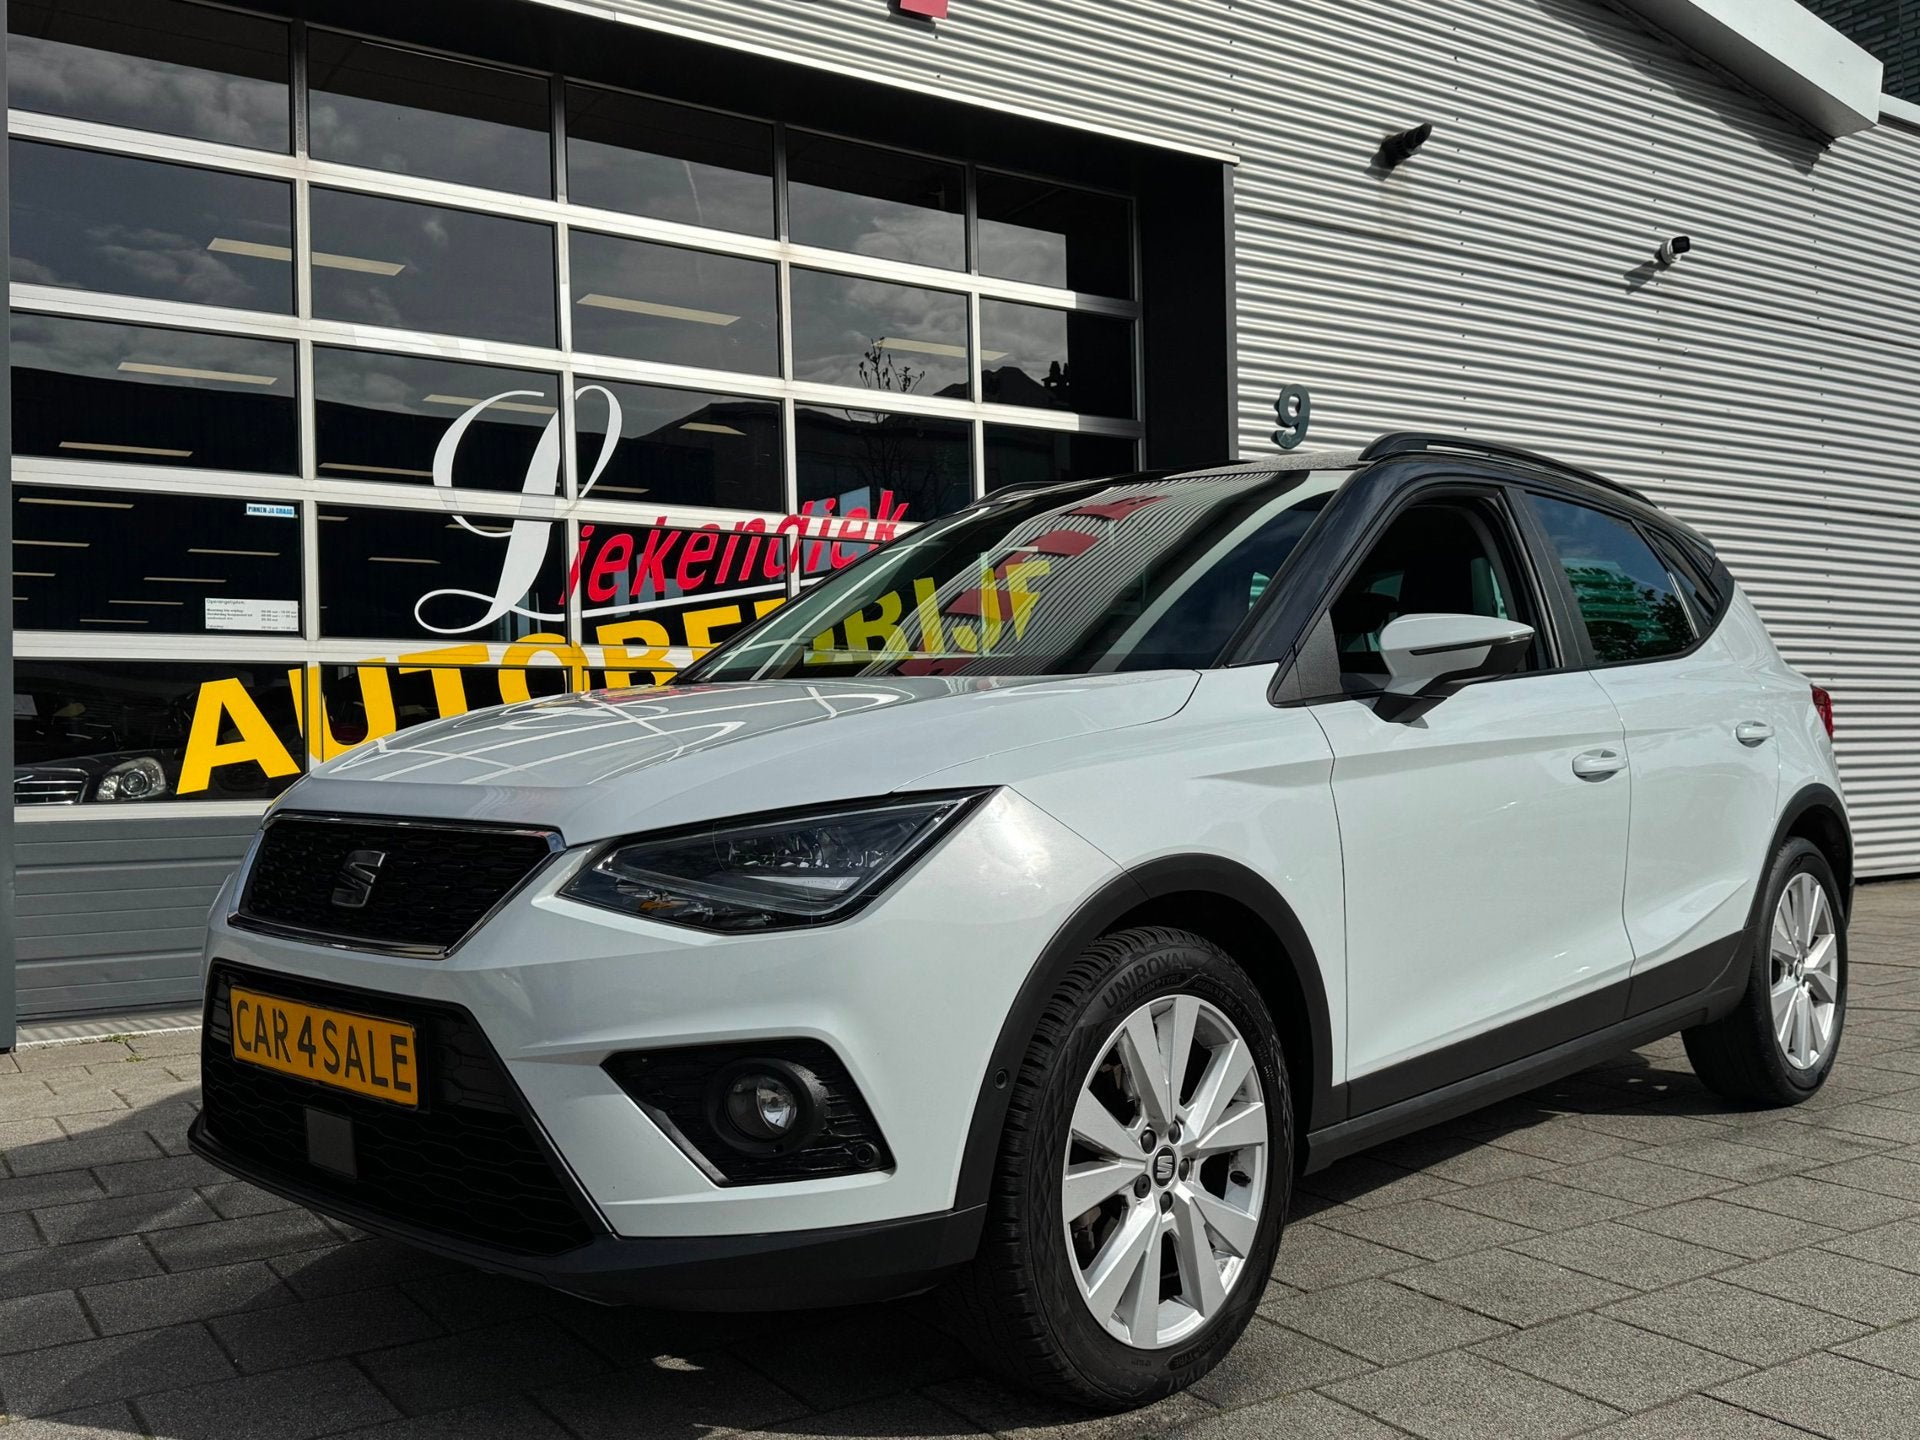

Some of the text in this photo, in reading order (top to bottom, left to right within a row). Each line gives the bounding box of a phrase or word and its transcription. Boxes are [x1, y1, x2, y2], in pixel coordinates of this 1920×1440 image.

[1276, 384, 1311, 449] 9
[414, 384, 910, 633] Liekendiek
[1101, 951, 1193, 1009] UNIROYAL
[236, 1000, 412, 1093] CAR 4 SALE
